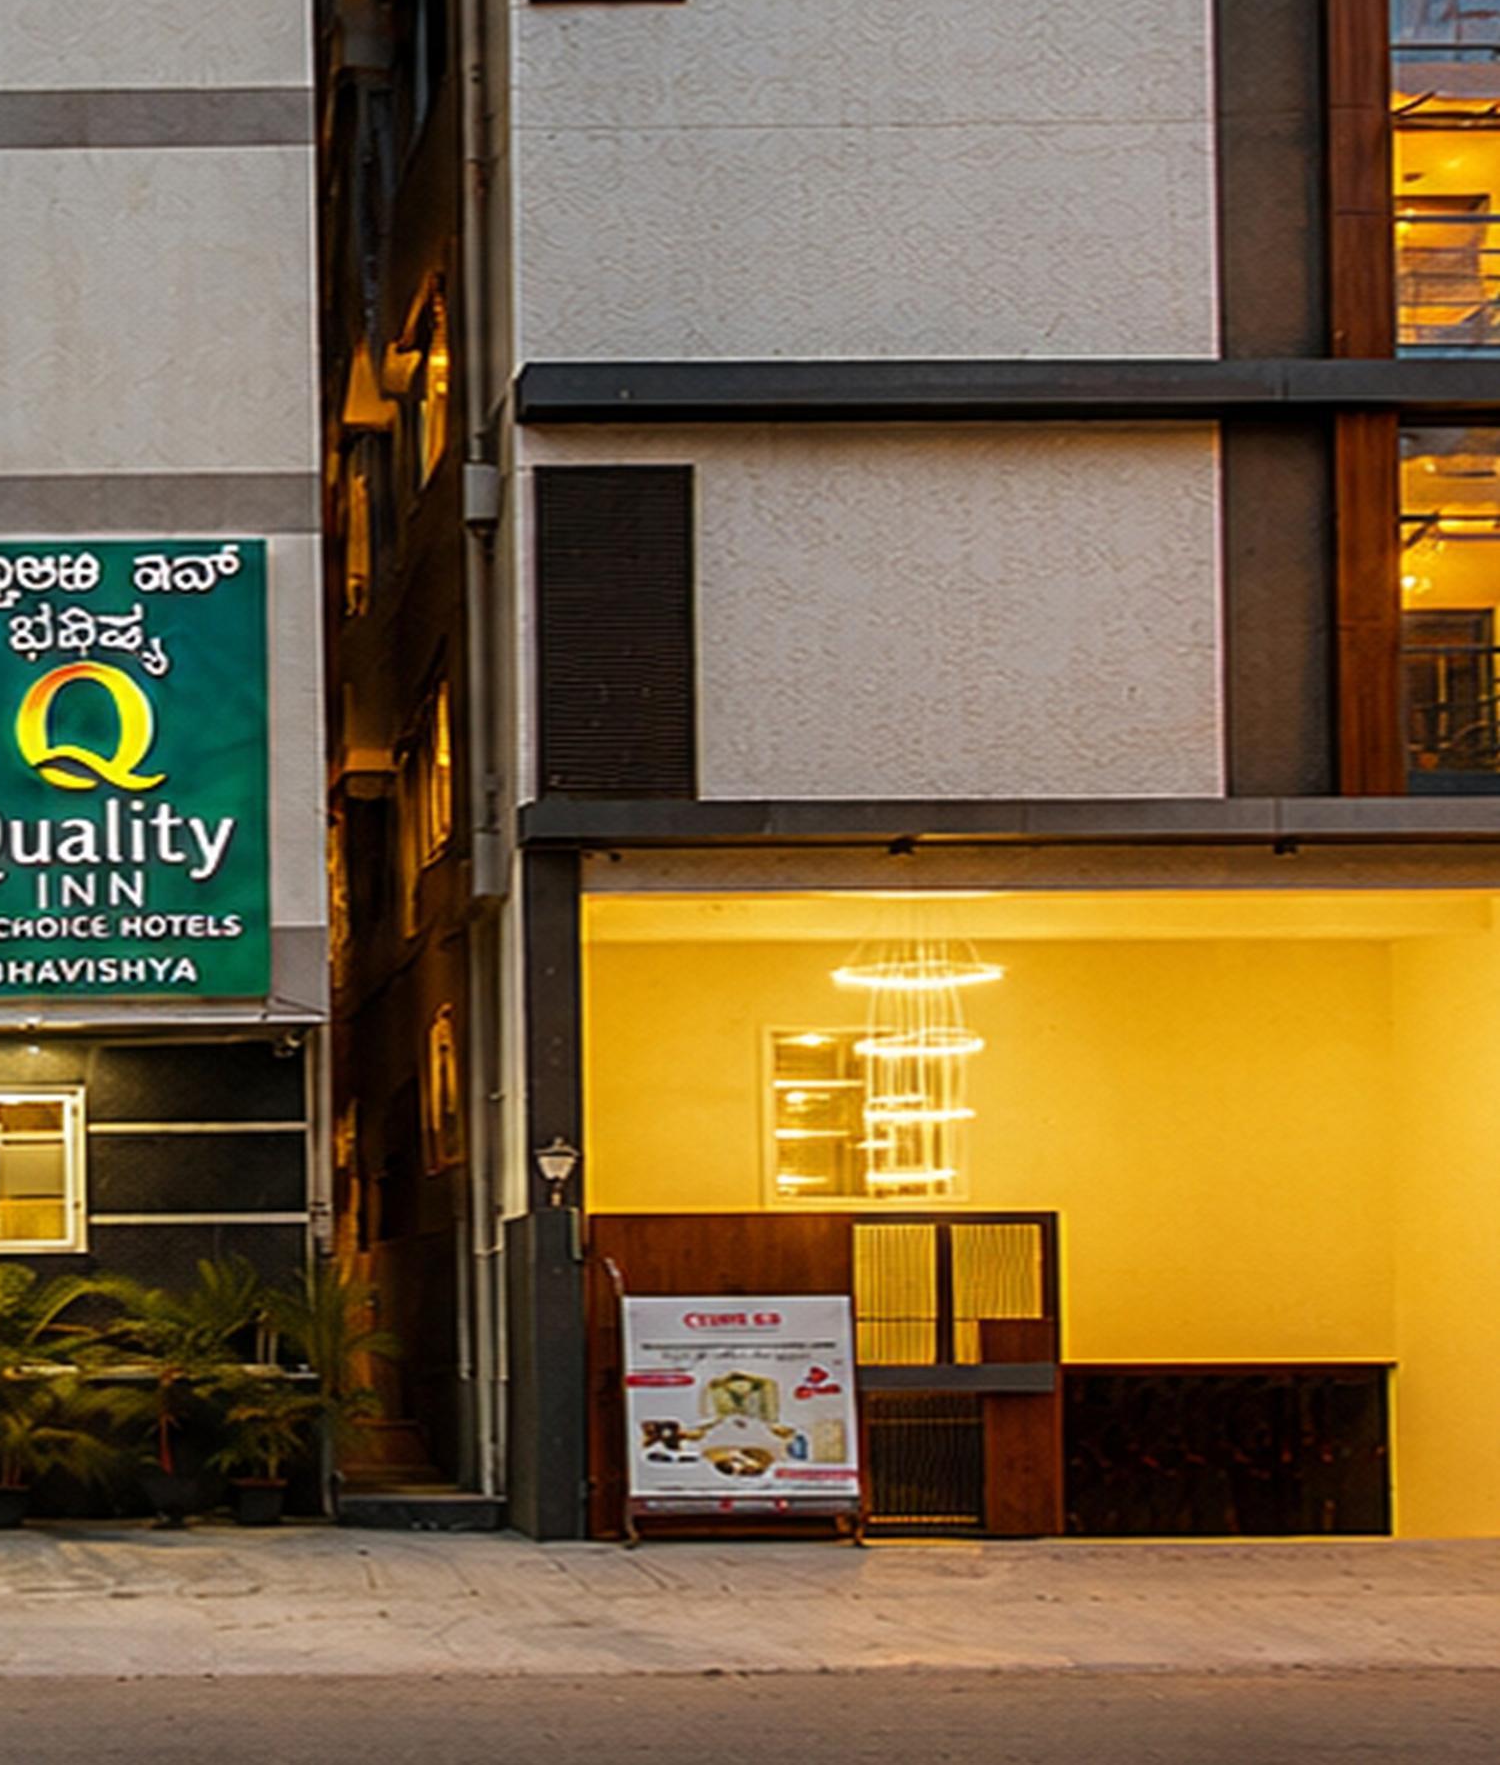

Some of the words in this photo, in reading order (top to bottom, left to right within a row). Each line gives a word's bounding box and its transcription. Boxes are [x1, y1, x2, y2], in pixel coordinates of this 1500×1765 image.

[16, 661, 167, 790] Q
[37, 871, 145, 909] INN
[121, 915, 242, 937] HOTELS
